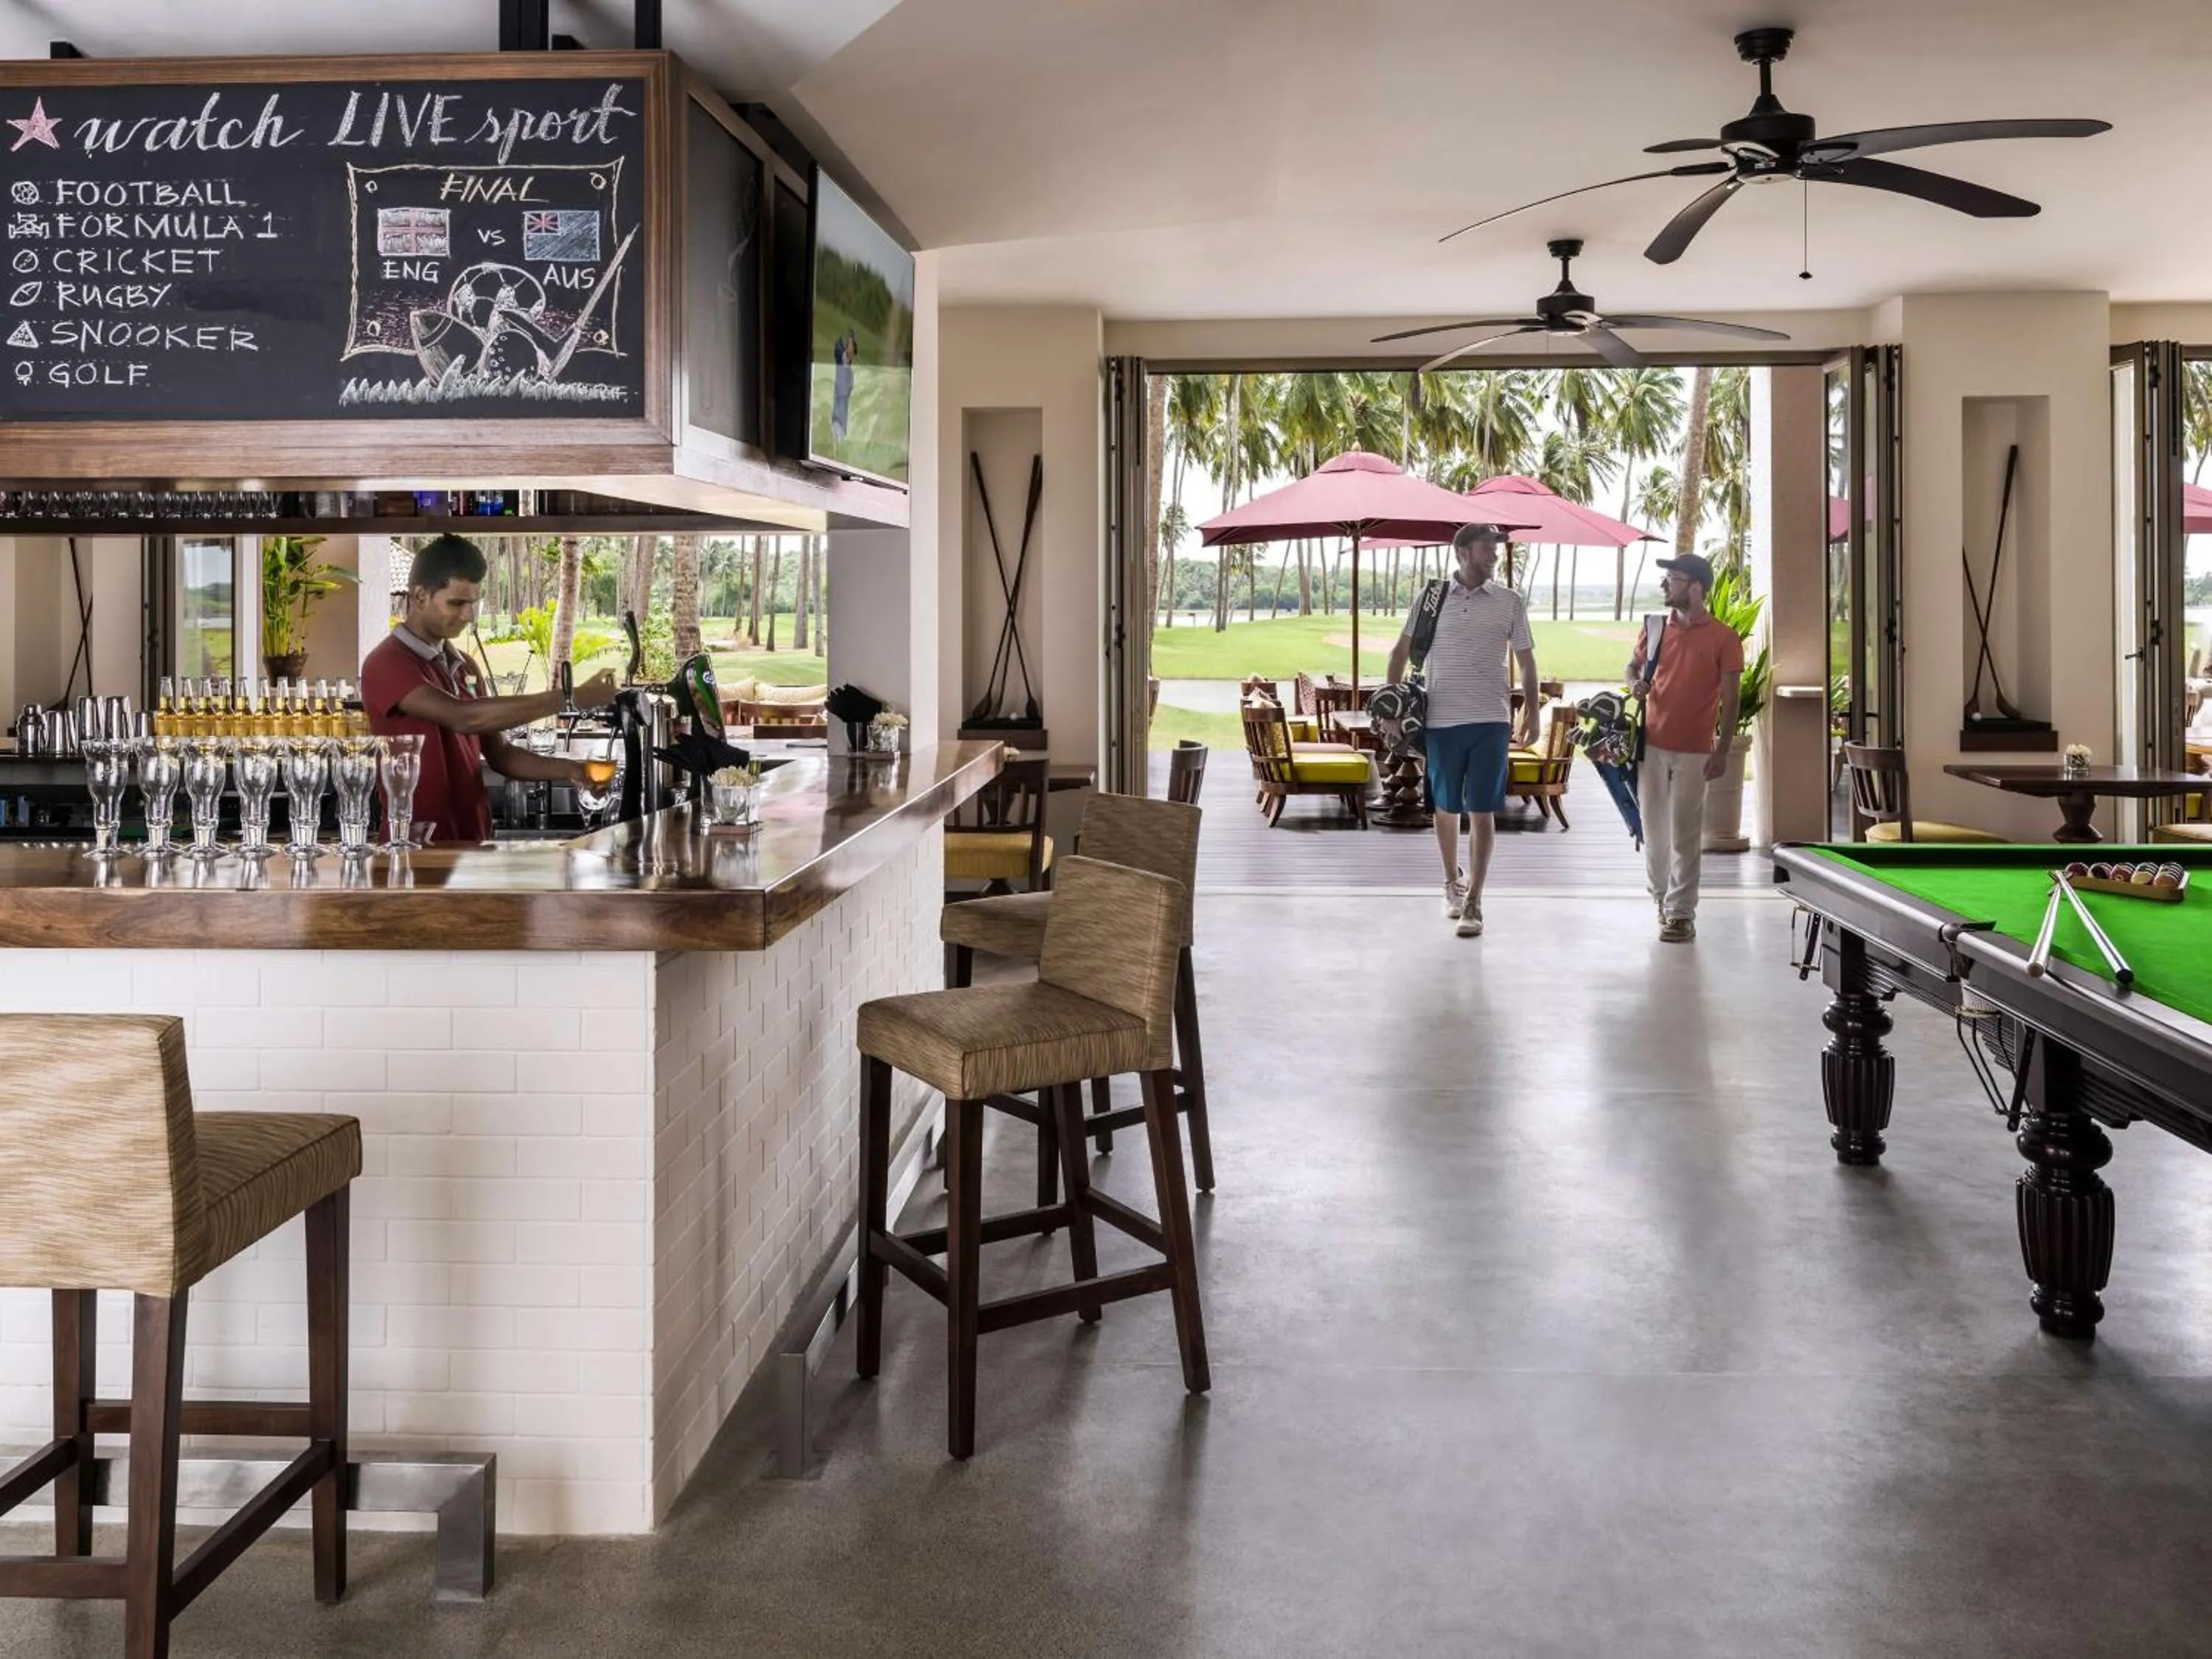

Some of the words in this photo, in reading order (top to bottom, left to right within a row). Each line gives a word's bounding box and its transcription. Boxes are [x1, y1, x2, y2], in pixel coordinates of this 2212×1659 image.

[74, 92, 304, 151] watch
[327, 91, 463, 147] LIVE
[464, 83, 637, 165] sport
[56, 178, 246, 206] FOOTBALL
[440, 173, 549, 204] FINAL
[56, 212, 244, 240] FORMULA
[257, 212, 278, 237] 1
[53, 248, 221, 275] CRICKET
[383, 261, 439, 283] ENG
[543, 264, 595, 289] AUS
[57, 281, 171, 310] RUGBY
[51, 320, 258, 353] SNOOKER
[49, 363, 149, 388] GOLF
